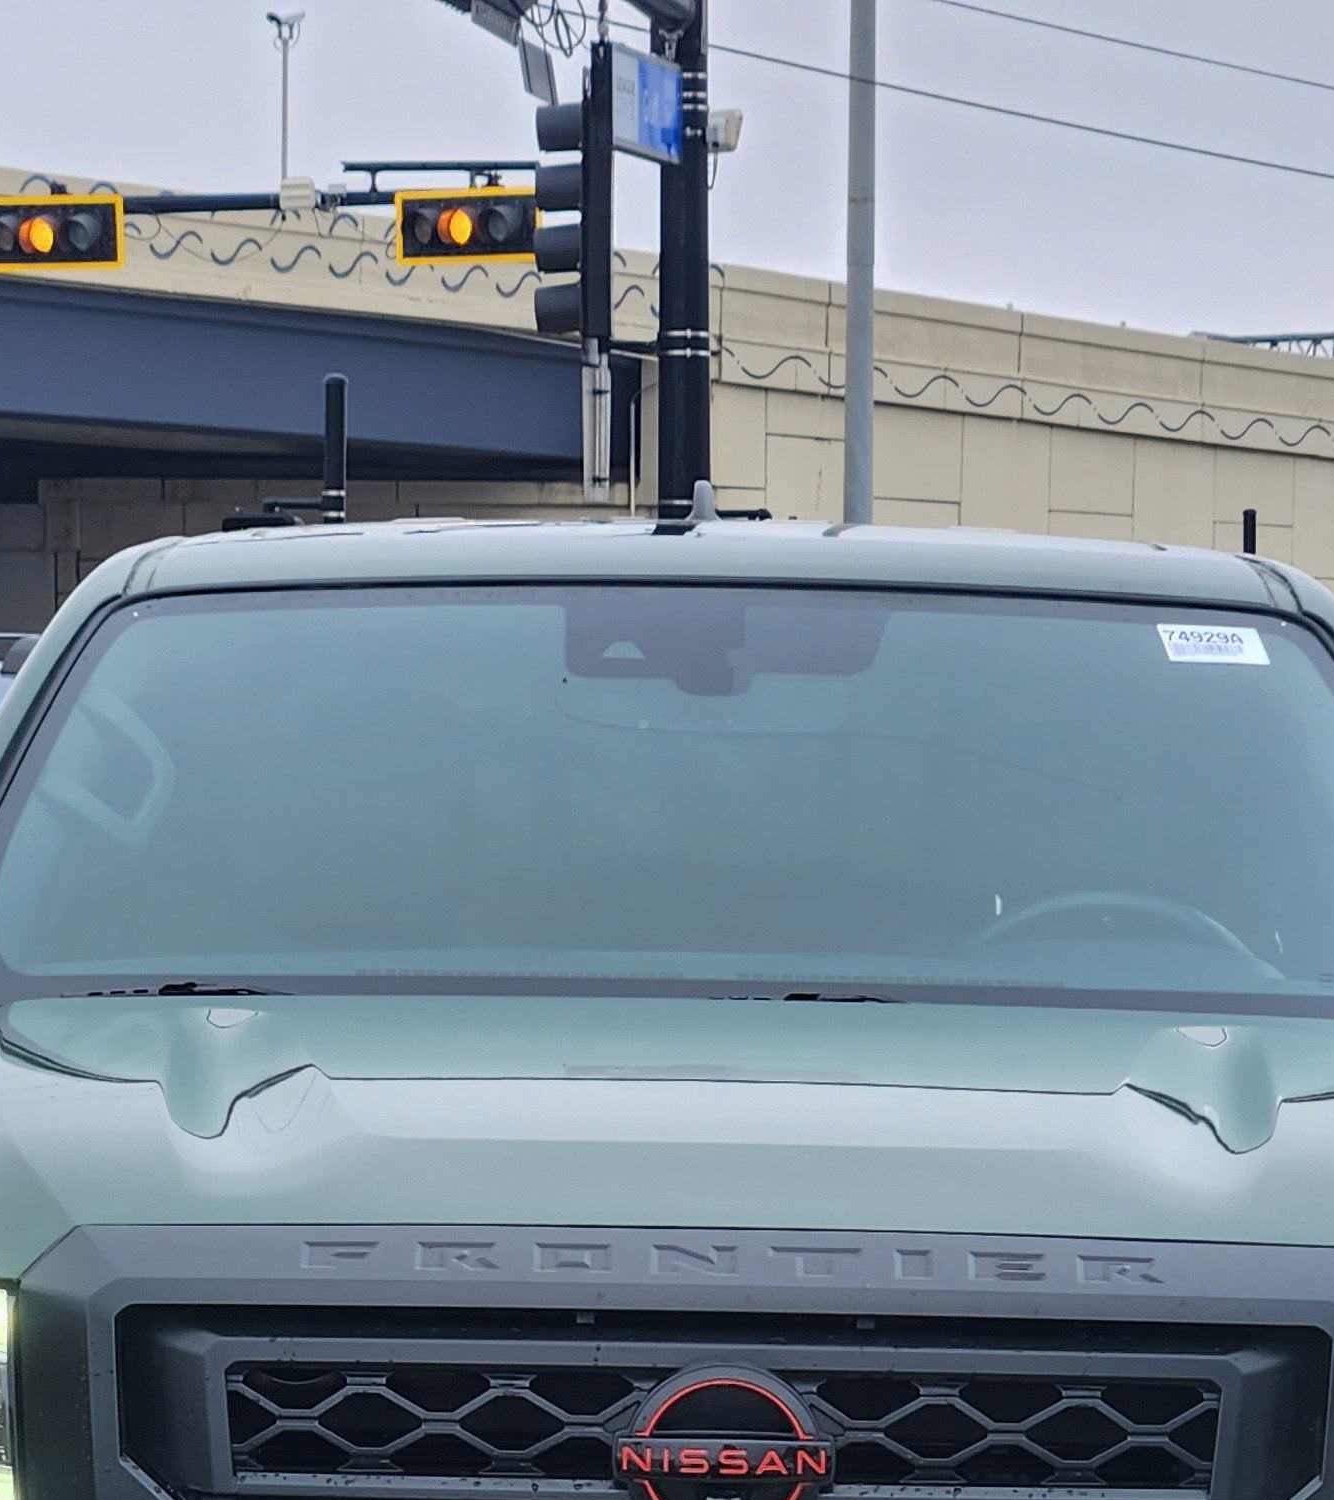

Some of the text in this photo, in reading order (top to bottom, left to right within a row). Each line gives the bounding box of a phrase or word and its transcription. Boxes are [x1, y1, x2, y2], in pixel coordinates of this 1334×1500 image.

[1162, 629, 1244, 645] 74929A
[300, 1240, 1165, 1286] FRONTIER
[619, 1442, 828, 1477] NISSAN
